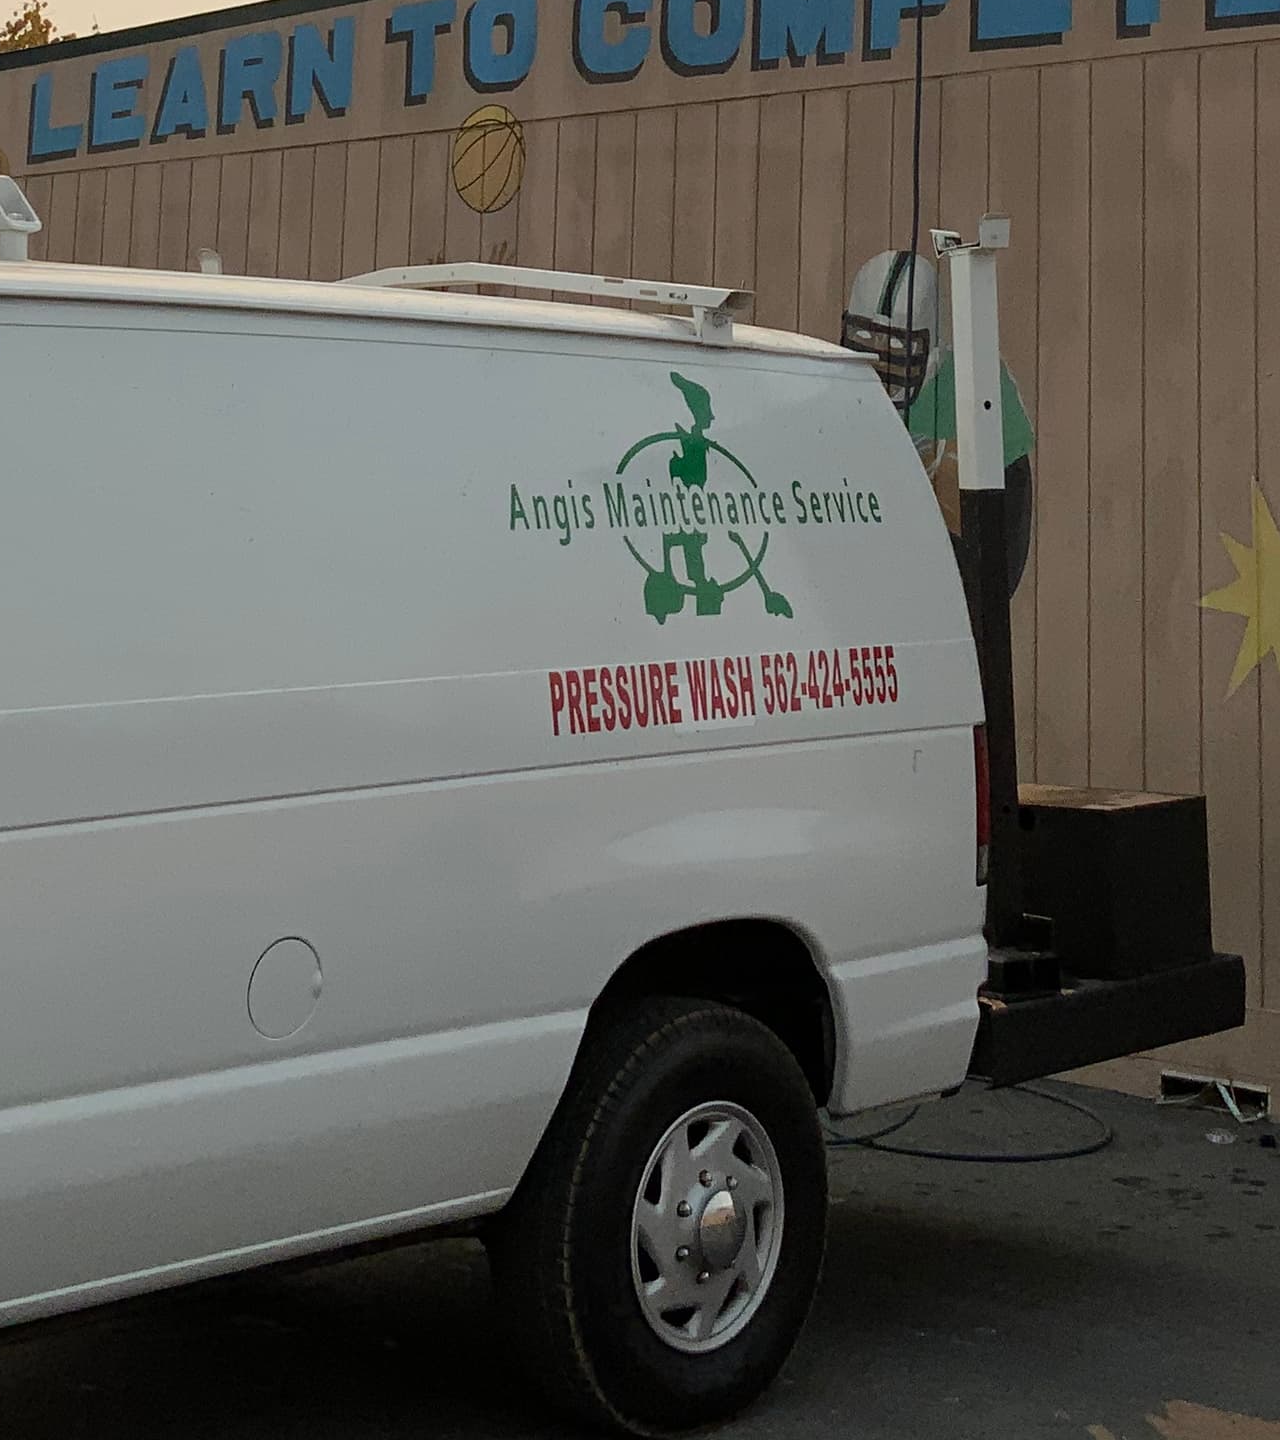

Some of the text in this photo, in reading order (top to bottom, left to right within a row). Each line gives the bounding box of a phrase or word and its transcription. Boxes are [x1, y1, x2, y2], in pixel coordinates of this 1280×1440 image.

[28, 15, 356, 160] LEARN
[509, 477, 883, 547] Angis Maintenance Service
[547, 645, 899, 737] PRESSURE WASH 562-424-5555
